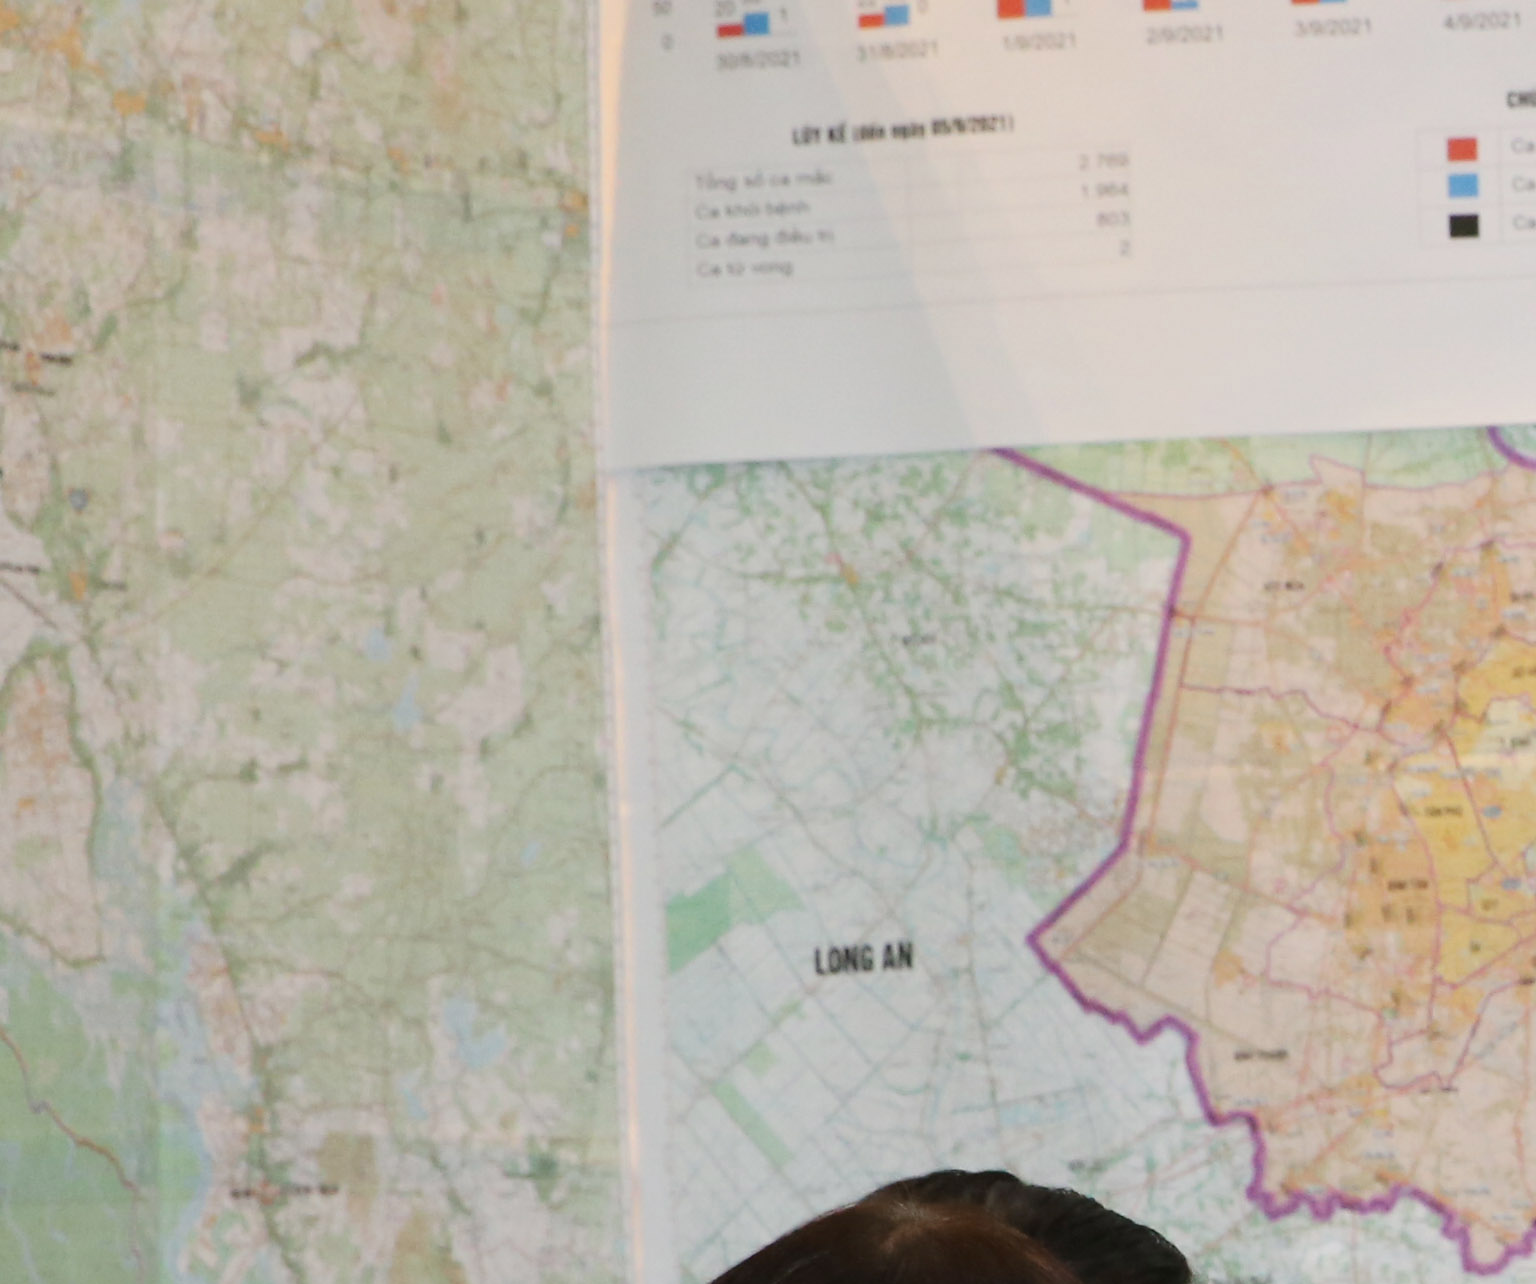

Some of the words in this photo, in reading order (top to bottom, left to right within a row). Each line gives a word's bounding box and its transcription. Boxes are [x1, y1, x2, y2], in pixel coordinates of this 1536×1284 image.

[1511, 136, 1536, 154] Ca
[769, 175, 789, 188] ca
[1512, 175, 1536, 193] Ca
[696, 205, 719, 220] Ca
[1513, 215, 1536, 231] Ca
[696, 233, 719, 249] Ca
[696, 261, 720, 278] Ca
[753, 260, 793, 279] vong
[814, 944, 874, 976] LONG
[882, 940, 914, 971] AN
